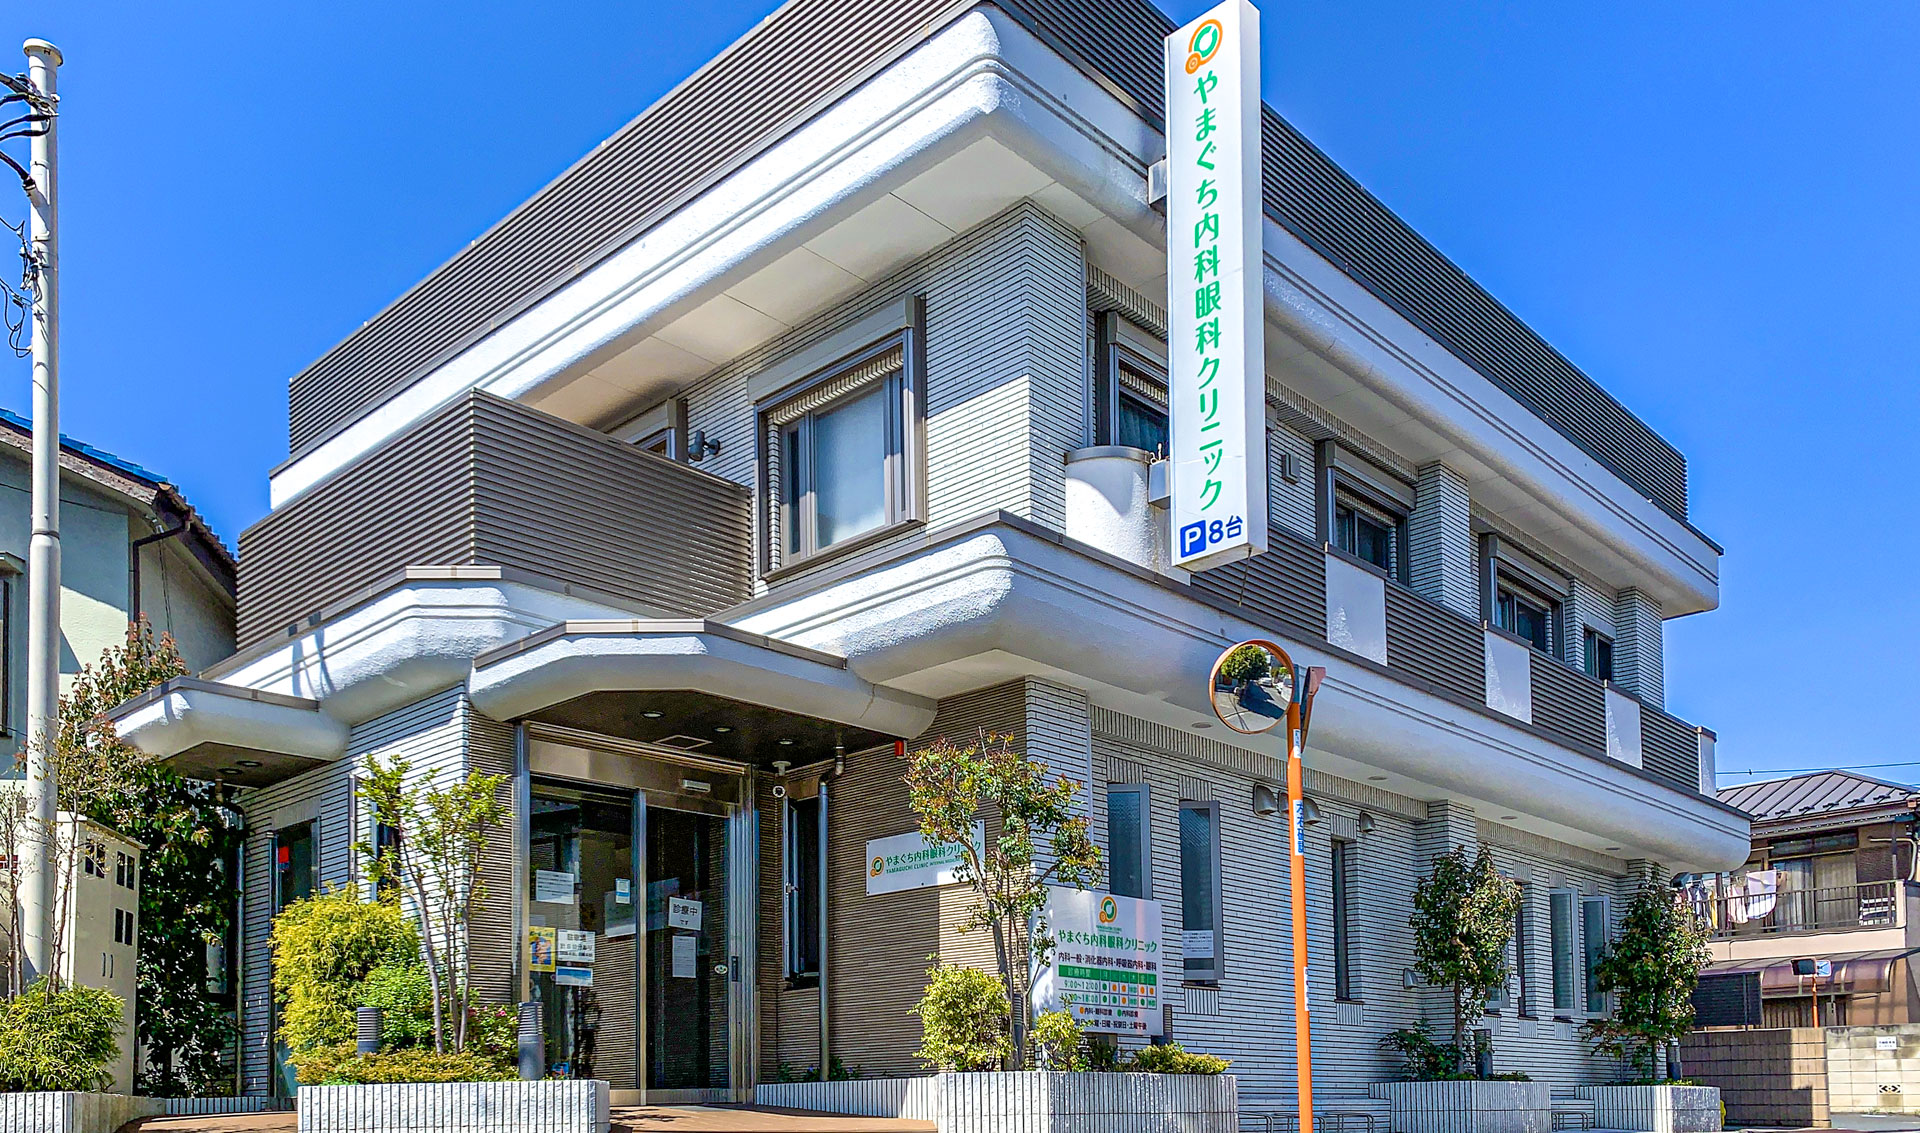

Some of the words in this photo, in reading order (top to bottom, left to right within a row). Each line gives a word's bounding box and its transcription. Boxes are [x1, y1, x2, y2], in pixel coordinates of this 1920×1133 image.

[1193, 70, 1222, 512] やまぐち内科眼科クリニック
[1185, 527, 1201, 553] P
[1209, 515, 1243, 544] 8台
[886, 840, 981, 866] やまぐち内科眼科クリク
[886, 864, 913, 874] YAMAGUCHI
[913, 861, 929, 870] CLINIC
[673, 903, 698, 917] 診療中
[1058, 929, 1158, 953] やまぐち内科眼科クリニック
